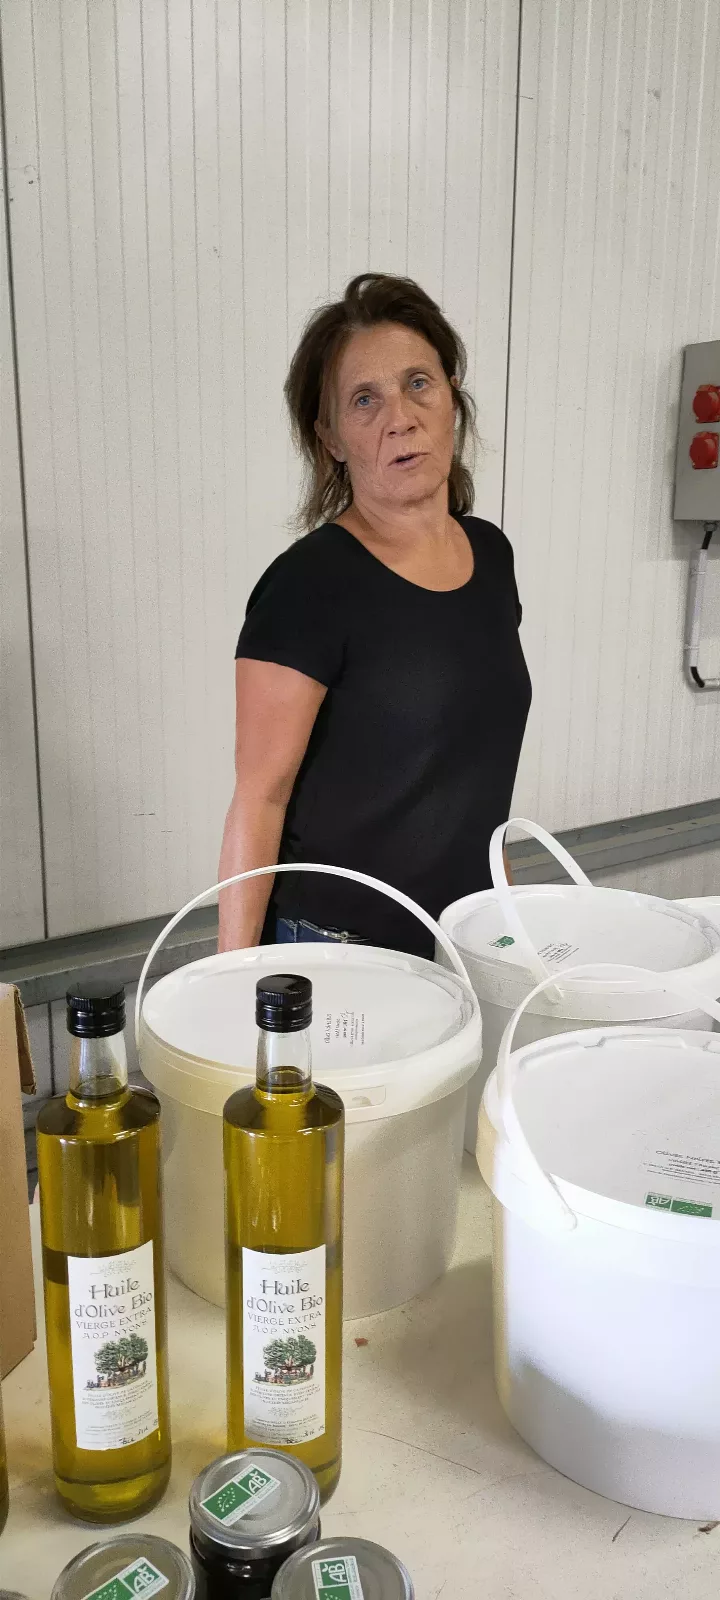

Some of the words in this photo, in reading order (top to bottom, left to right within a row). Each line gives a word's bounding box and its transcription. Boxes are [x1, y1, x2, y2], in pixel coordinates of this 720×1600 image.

[88, 1278, 140, 1300] Huile
[260, 1279, 310, 1295] Huile
[74, 1303, 126, 1318] d'Olive
[132, 1291, 153, 1310] Bio
[246, 1296, 296, 1314] d'Olive
[301, 1294, 323, 1311] Bio
[75, 1320, 116, 1330] VIERGE
[119, 1306, 152, 1326] EXTRA
[247, 1311, 285, 1326] VIERGE
[288, 1310, 322, 1325] EXTRA
[248, 1475, 267, 1494] AB
[133, 1570, 154, 1593] AB
[328, 1563, 347, 1583] AB
